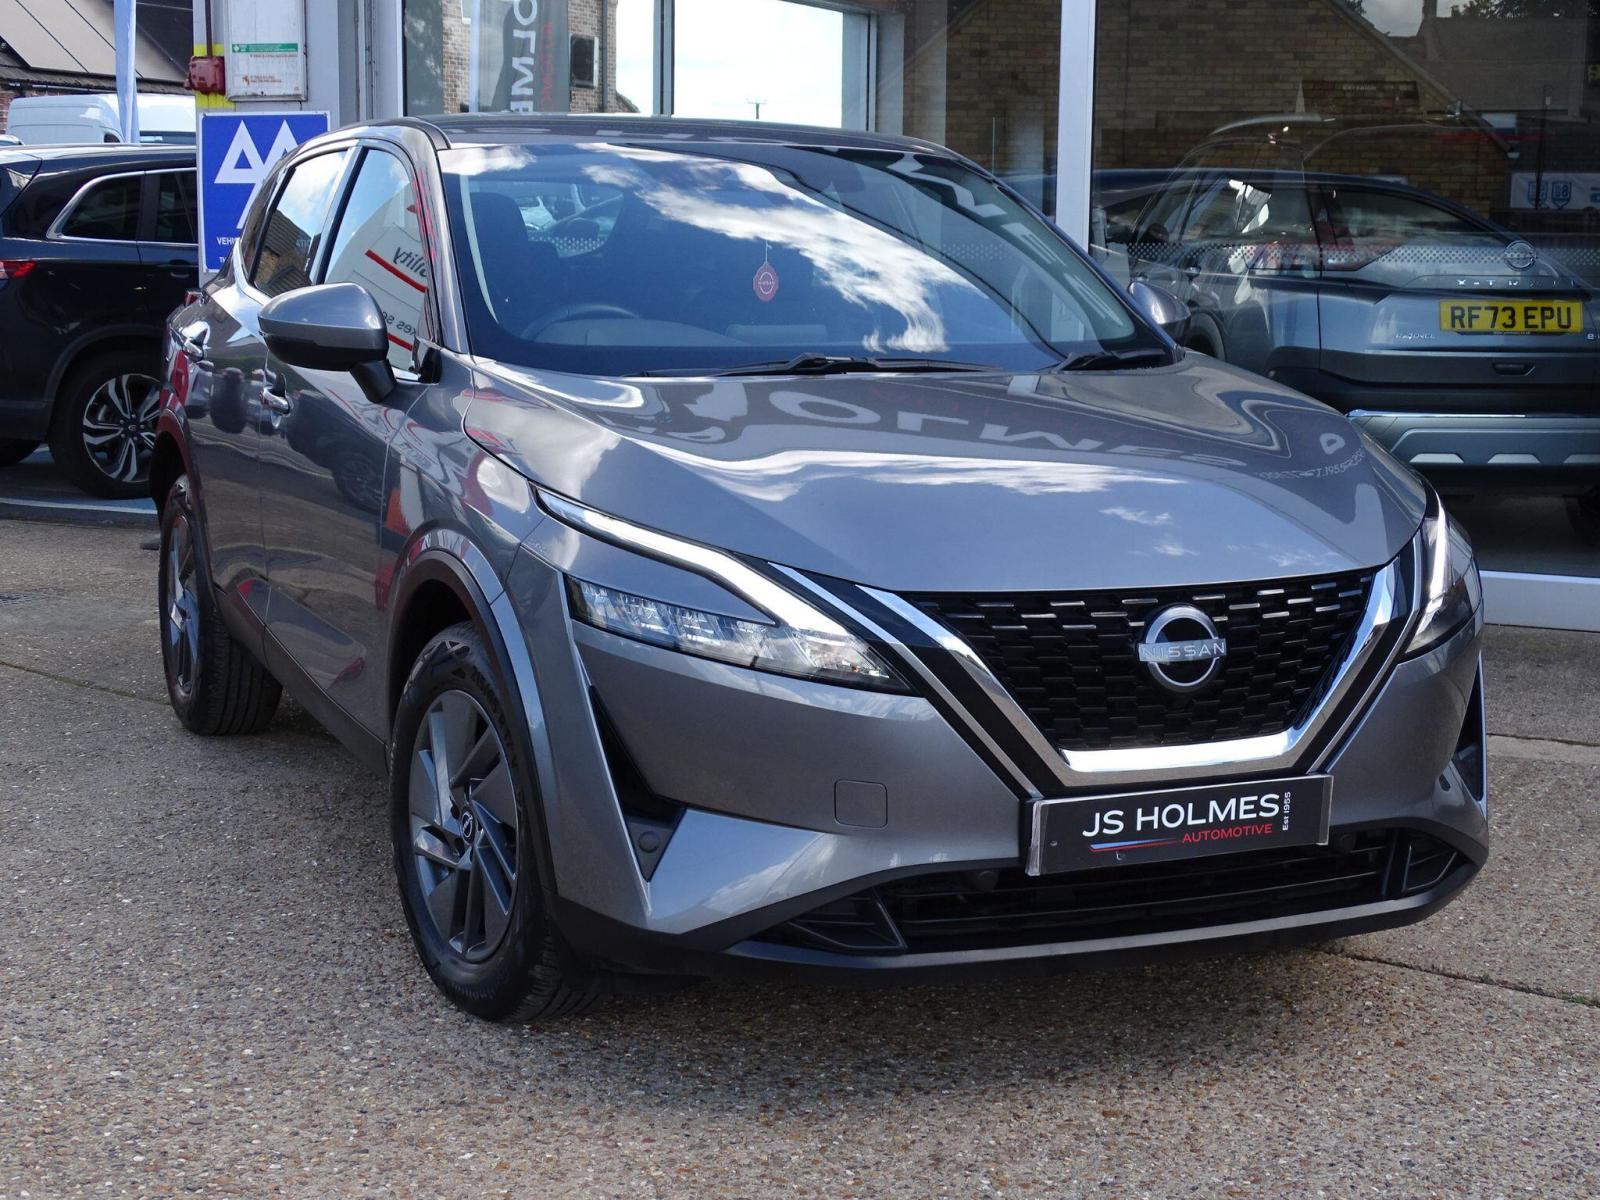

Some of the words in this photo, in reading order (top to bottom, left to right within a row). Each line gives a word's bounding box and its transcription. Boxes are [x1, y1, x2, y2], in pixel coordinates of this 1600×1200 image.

[1451, 306, 1516, 330] RF73
[1523, 306, 1572, 330] EPU
[1142, 642, 1225, 658] NISSAN
[1283, 791, 1292, 814] 1955
[1082, 809, 1124, 837] JS
[1136, 793, 1280, 831] HOLMES
[1182, 823, 1272, 844] AUTOMOTIVE
